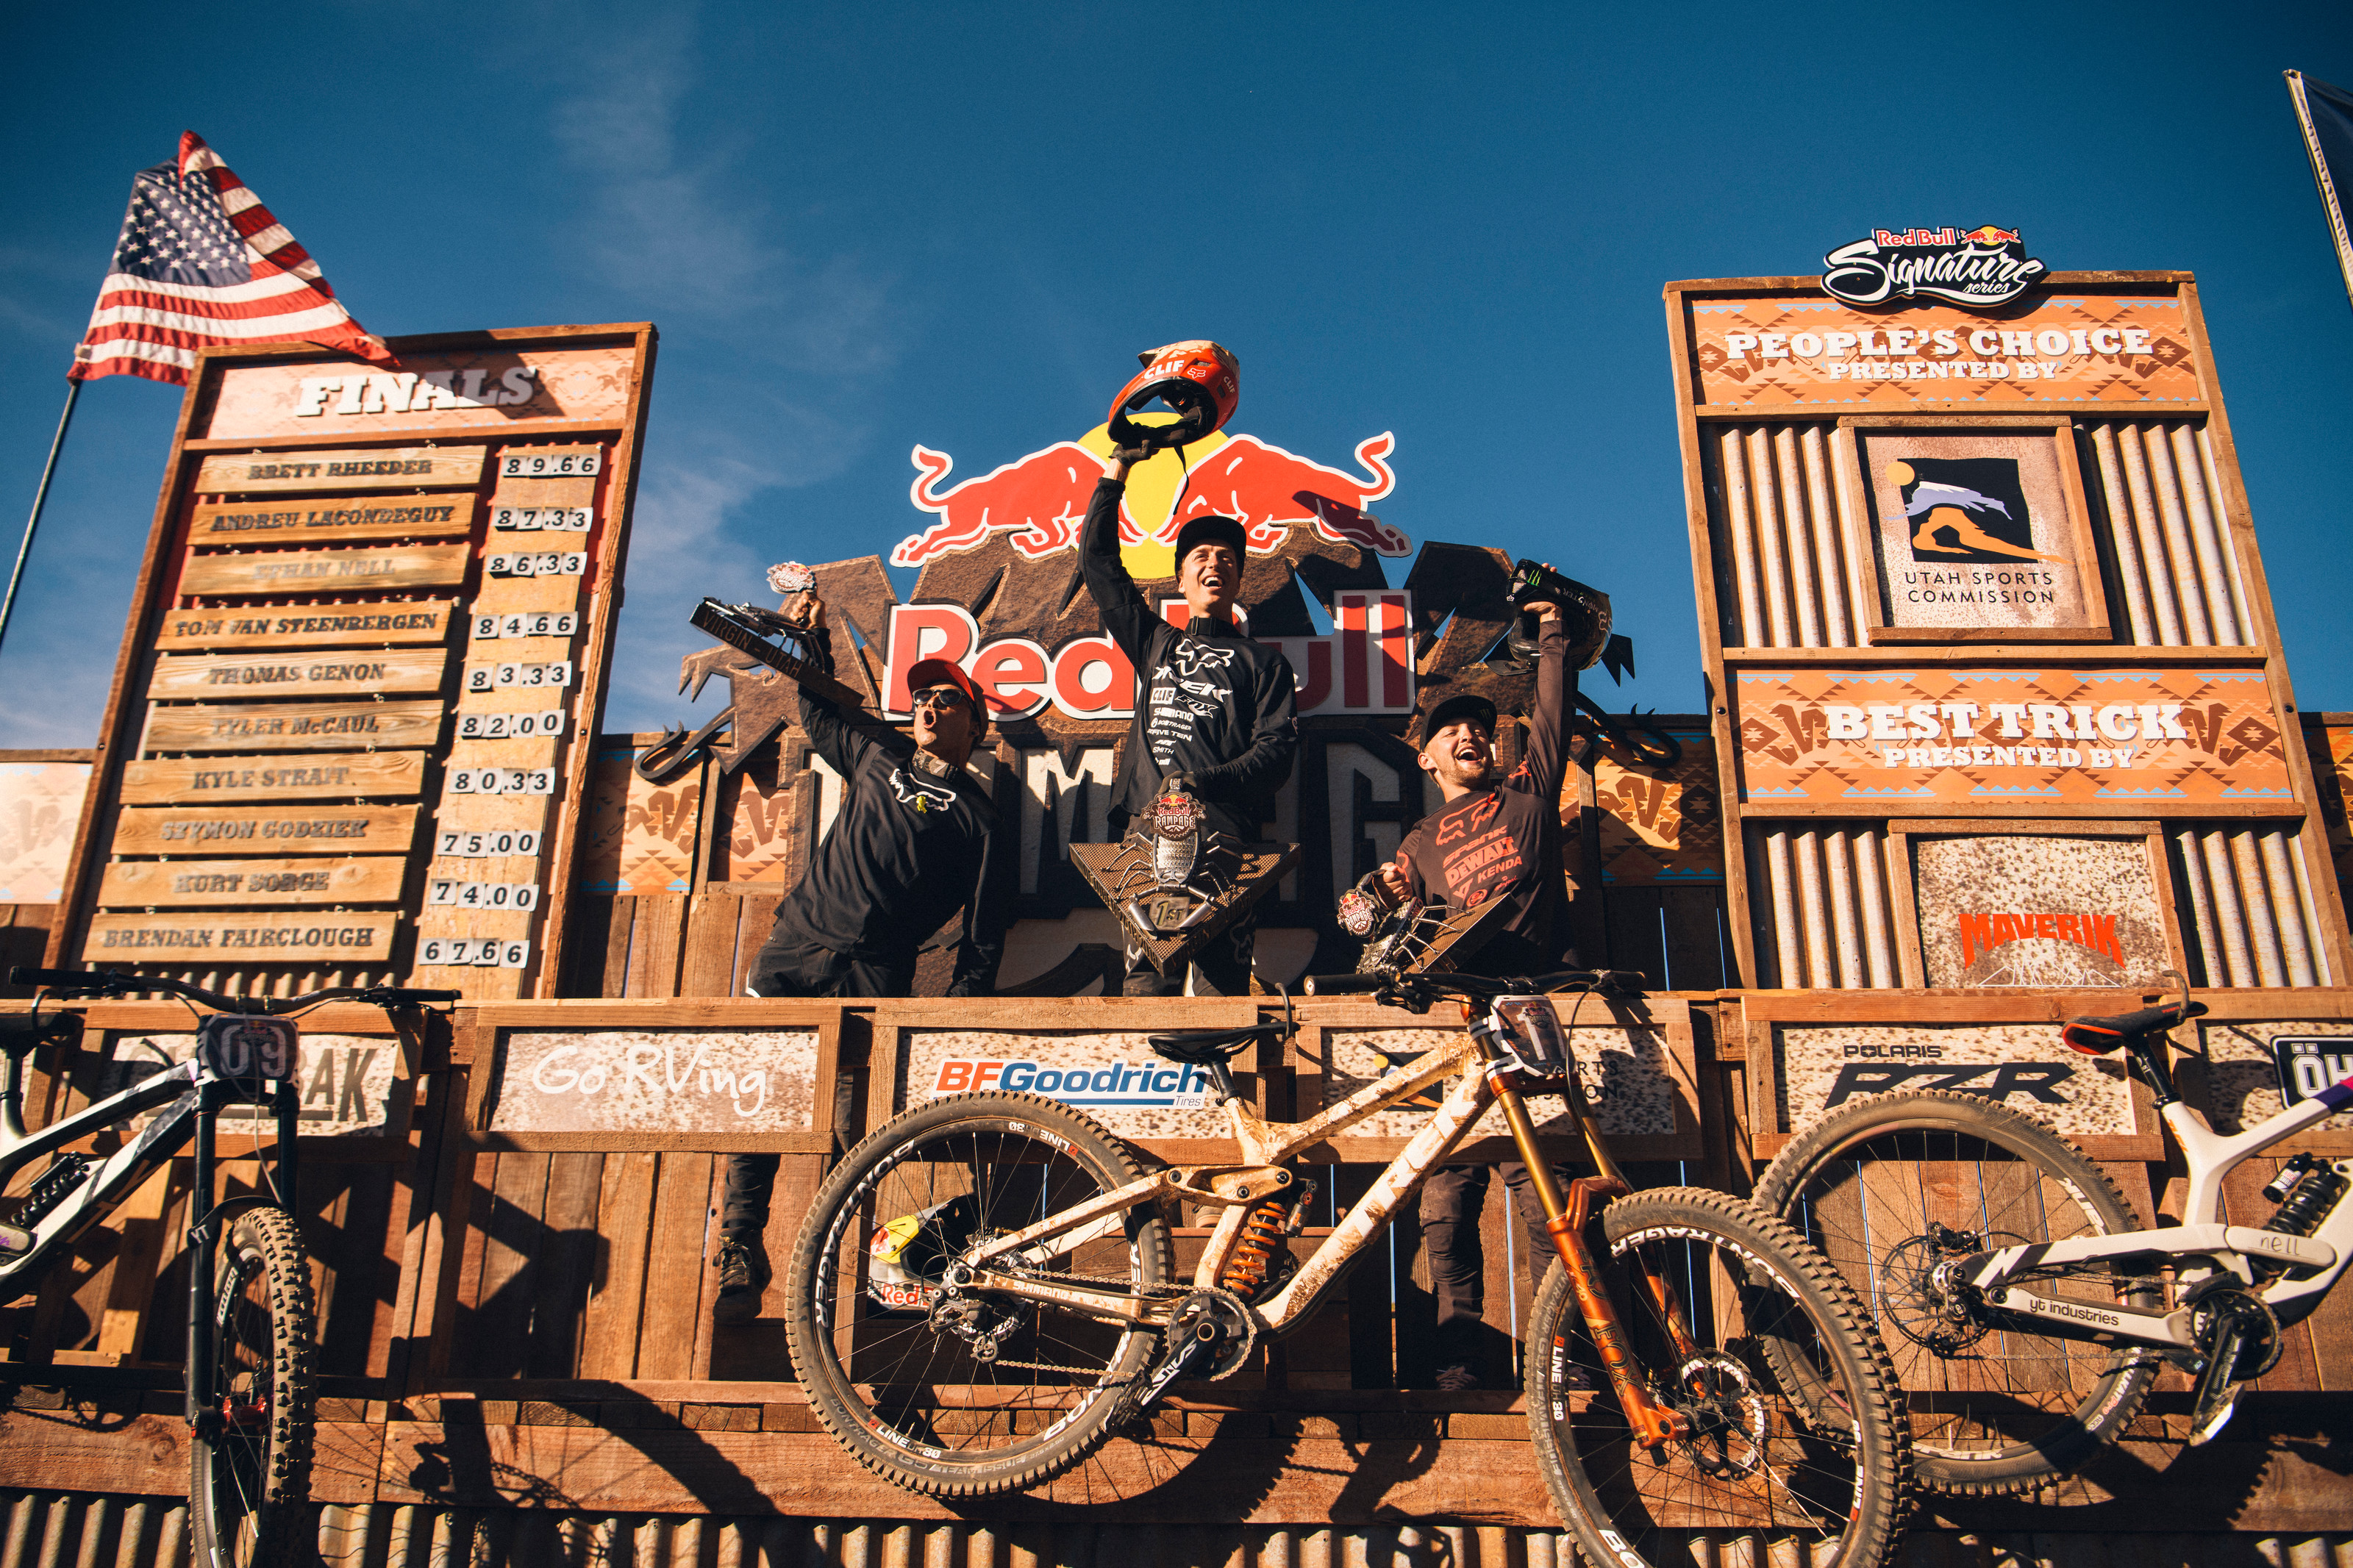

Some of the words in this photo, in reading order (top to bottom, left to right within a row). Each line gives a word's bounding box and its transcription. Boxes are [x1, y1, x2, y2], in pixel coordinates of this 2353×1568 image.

[1877, 229, 1915, 246] Red
[1917, 228, 1956, 246] Bull
[1824, 240, 2044, 303] Signature
[1963, 278, 2010, 293] series
[1726, 329, 1958, 359] PEOPLE'S
[1968, 329, 2153, 357] CHOICE
[1143, 359, 1185, 379] CLIF
[1828, 361, 2011, 381] PRESENTED
[2018, 361, 2060, 379] BY
[295, 366, 538, 417] FINALS
[1223, 376, 1235, 394] CLIF
[248, 462, 324, 480] BRETT
[328, 459, 432, 477] RHEEDER
[506, 455, 596, 474] 89.66
[210, 509, 299, 531] ANDREU
[304, 505, 456, 529] LACONDEGUY
[496, 509, 587, 529] 87.33
[252, 562, 330, 581] ETHAN
[336, 559, 396, 576] NELL
[492, 555, 581, 573] 86.33
[1905, 572, 1961, 586] UTAH
[1973, 570, 2052, 586] SPORTS
[1907, 590, 2054, 604] COMMISSION
[175, 618, 226, 638] TOM
[229, 617, 275, 636] VAN
[279, 612, 438, 633] STEENBERGEN
[479, 615, 571, 634] 84.66
[702, 611, 752, 651] VIRGIN
[765, 648, 803, 679] UTAH
[882, 603, 1146, 720] Red
[210, 665, 301, 684] THOMAS
[307, 663, 386, 681] GENON
[471, 665, 565, 689] 83.33
[213, 717, 284, 735] TYLER
[293, 715, 379, 734] McCAUL
[464, 714, 558, 735] 82.00
[1824, 703, 1980, 741] BEST
[1990, 703, 2188, 741] TRICK
[1171, 730, 1193, 742] TEN
[1152, 745, 1174, 755] SMITH
[1882, 747, 2082, 769] PRESENTED
[2088, 747, 2135, 769] BY
[192, 770, 258, 790] KYLE
[263, 767, 350, 787] STRAIT
[454, 772, 549, 792] 80.33
[1158, 807, 1174, 815] Red
[1174, 806, 1190, 815] Bull
[160, 820, 255, 840] SZYMON
[262, 819, 369, 839] GODZIEK
[1155, 815, 1196, 828] RAMPAGE
[445, 833, 533, 853] 75.00
[1446, 837, 1516, 887] DEWALT
[1477, 856, 1523, 884] KENDA
[173, 873, 243, 894] KURT
[247, 871, 330, 892] SORGE
[436, 884, 531, 908] 74.00
[102, 928, 215, 948] BRENDAN
[220, 927, 374, 948] FAIRCLOUGH
[1958, 913, 2127, 970] MAVERIK
[425, 941, 522, 964] 67.66
[1843, 1045, 1942, 1059] POLARIS
[532, 1045, 606, 1095] Go
[625, 1042, 767, 1118] RVing
[936, 1062, 1213, 1094] BFGoodrich
[1174, 1095, 1202, 1107] Tires
[1040, 1129, 1071, 1151] LINE
[190, 1224, 210, 1244] YT
[815, 1140, 914, 1329] BONTRAGER
[2261, 1236, 2301, 1256] nell
[1610, 1225, 1801, 1298] BONTRAGER
[882, 1283, 921, 1307] Red
[1013, 1282, 1066, 1300] SHIMANO
[2029, 1298, 2046, 1314] yt
[2049, 1300, 2119, 1327] industries
[1551, 1346, 1564, 1383] LINE
[1593, 1325, 1641, 1397] FOX
[1552, 1401, 1564, 1421] 30
[830, 1397, 897, 1461] BONTRAGER
[875, 1425, 910, 1447] LINE
[923, 1447, 942, 1459] 30
